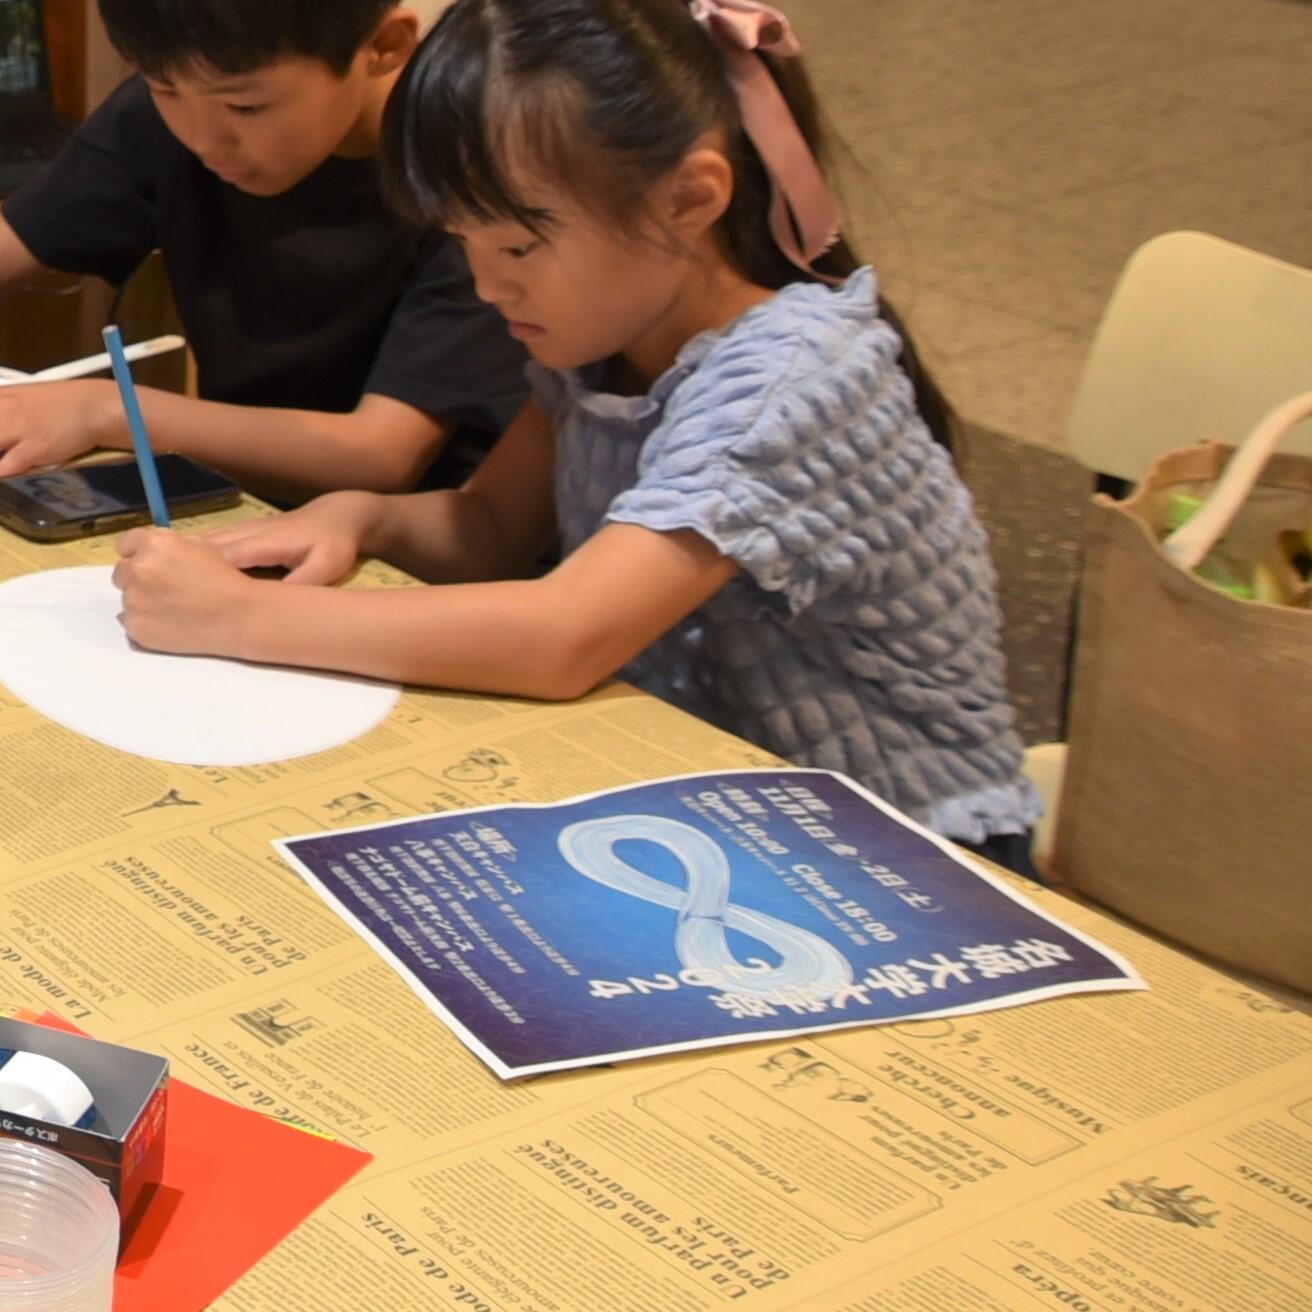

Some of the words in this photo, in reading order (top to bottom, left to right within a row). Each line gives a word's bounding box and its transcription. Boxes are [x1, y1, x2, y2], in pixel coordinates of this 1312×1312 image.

[103, 858, 179, 910] distingué
[688, 791, 750, 822] Open
[784, 863, 851, 899] Close
[828, 900, 905, 942] 18:00
[126, 855, 220, 924] amoureuses
[177, 910, 247, 955] parfum
[236, 915, 284, 948] Paris
[250, 937, 293, 969] pour
[282, 944, 307, 963] de
[20, 961, 67, 1000] mode
[242, 954, 268, 977] Un
[577, 957, 782, 1000] 2024
[705, 935, 1082, 1020] 名城大学大学祭
[64, 997, 93, 1020] La
[184, 1043, 249, 1091] France
[883, 1050, 1013, 1120] annonceur
[248, 1089, 276, 1106] de
[877, 1064, 977, 1122] Cherche
[1004, 1073, 1115, 1134] Musique
[514, 1143, 618, 1211] distingué
[541, 1139, 671, 1225] amoureuses
[361, 1212, 419, 1257] Paris
[422, 1206, 456, 1234] Paris
[620, 1211, 702, 1268] parfum
[674, 1225, 712, 1249] les
[690, 1216, 756, 1260] Paris
[426, 1231, 466, 1257] pour
[419, 1258, 450, 1280] de
[705, 1270, 748, 1302] Un
[712, 1247, 775, 1291] pour
[755, 1260, 792, 1283] de
